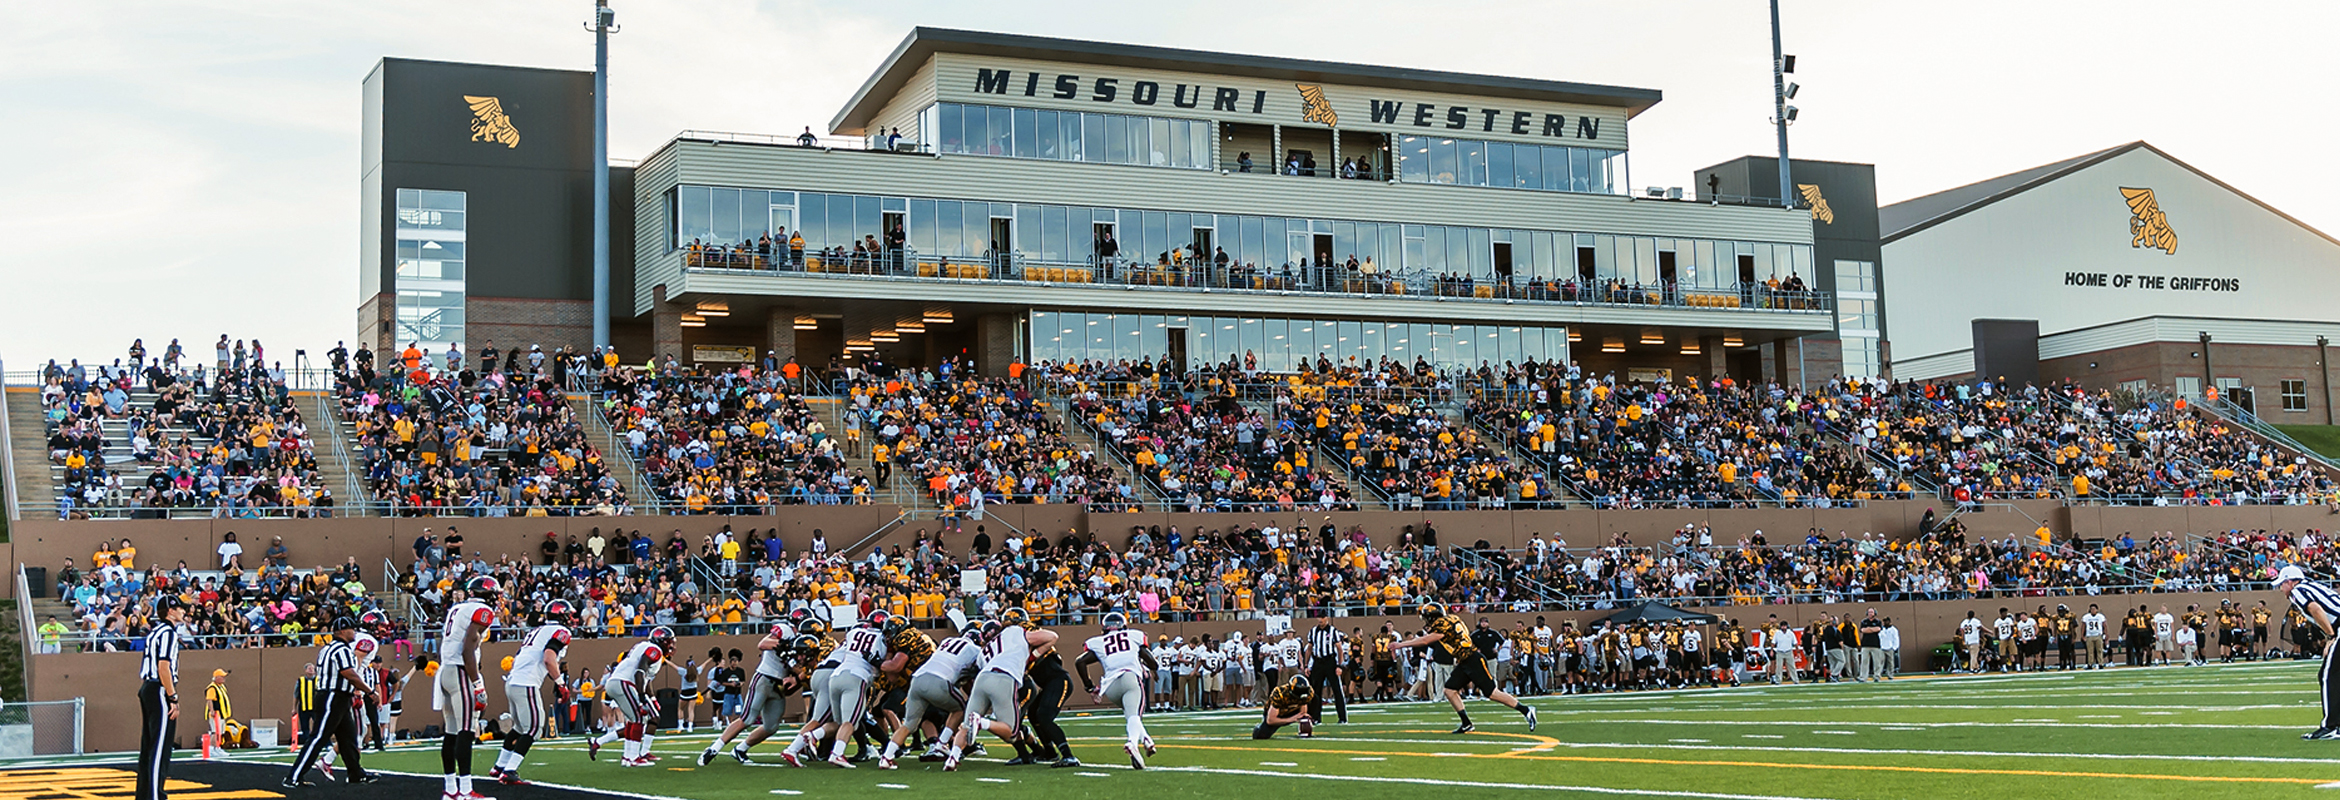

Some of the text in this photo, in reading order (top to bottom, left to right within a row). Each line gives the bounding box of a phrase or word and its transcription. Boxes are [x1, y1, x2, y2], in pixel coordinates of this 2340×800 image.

[974, 68, 1600, 140] MISSOURI WESTERN
[2065, 272, 2240, 291] HOME OF THE GRIFFONS
[2089, 621, 2099, 631] 94
[849, 631, 877, 654] 98
[1103, 632, 1131, 656] 26
